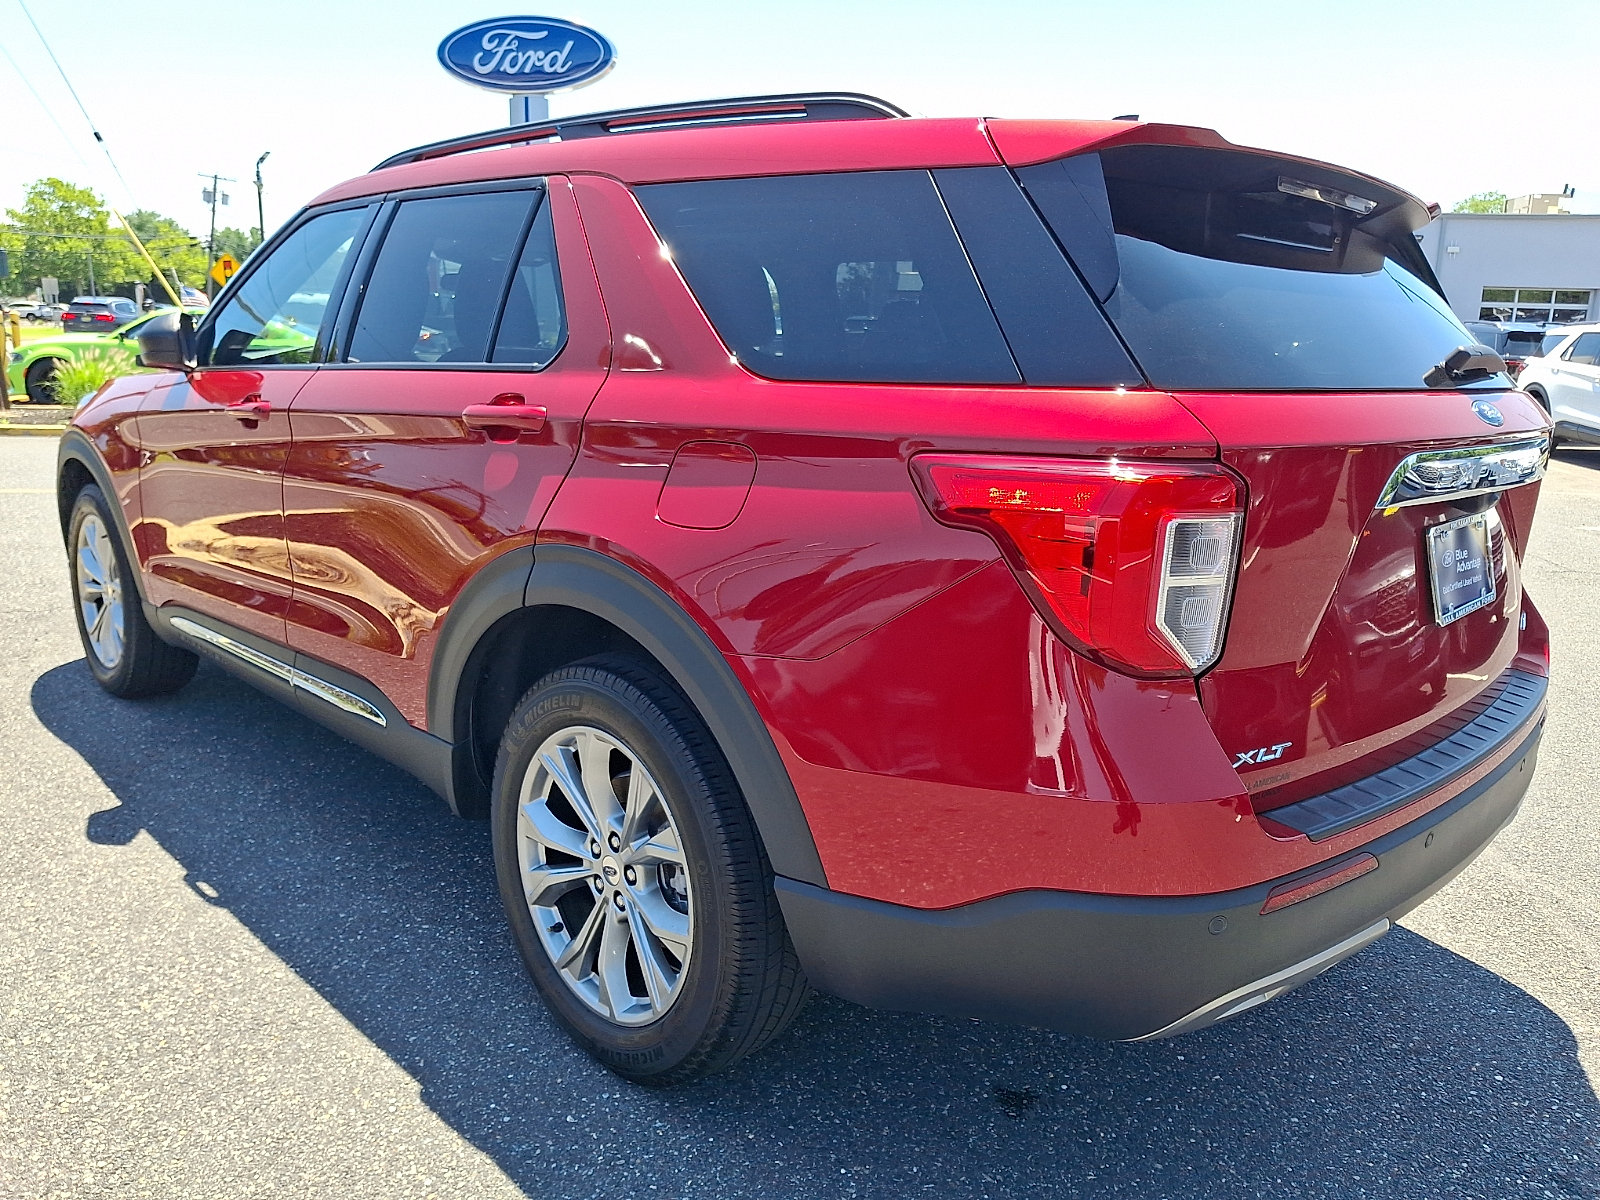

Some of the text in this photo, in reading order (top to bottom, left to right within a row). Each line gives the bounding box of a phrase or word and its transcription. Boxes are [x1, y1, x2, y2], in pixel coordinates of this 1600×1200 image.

[473, 29, 574, 75] Ford
[1455, 549, 1469, 561] Blue
[1455, 602, 1481, 619] AMERICAN
[524, 695, 582, 728] MICHELIN
[1232, 742, 1292, 769] XLT
